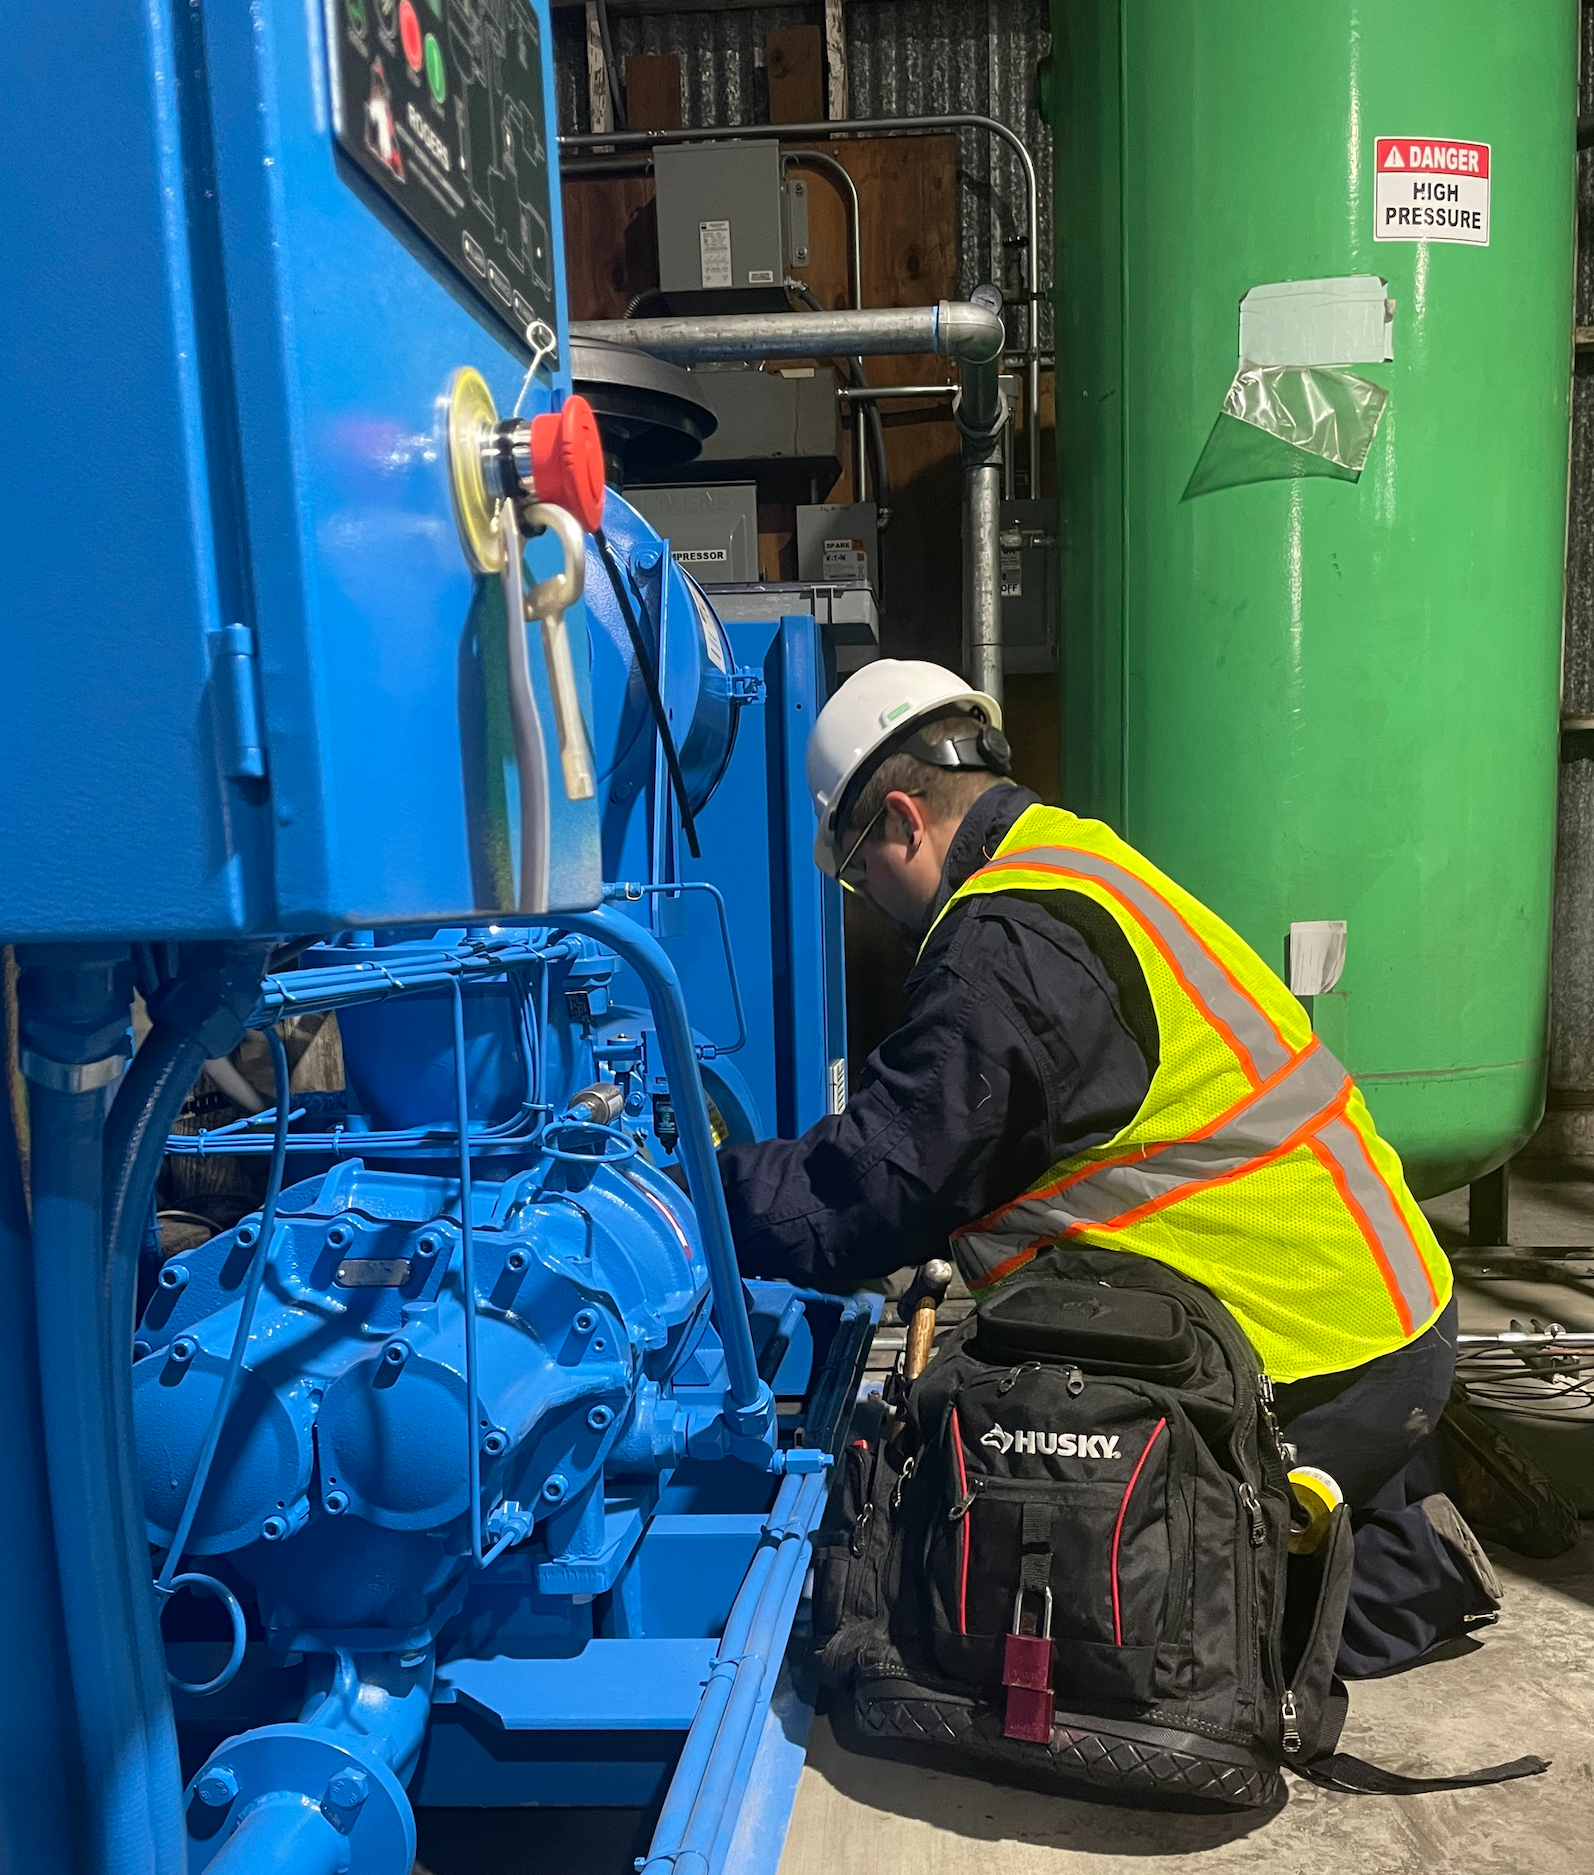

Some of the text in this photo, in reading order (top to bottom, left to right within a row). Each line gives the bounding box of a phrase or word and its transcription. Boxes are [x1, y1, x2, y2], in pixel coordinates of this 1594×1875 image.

[1409, 145, 1480, 173] DANGER
[1413, 182, 1459, 202] HIGH
[1385, 207, 1481, 230] PRESSURE
[1000, 583, 1018, 593] OFF
[1014, 1430, 1120, 1459] HUSKY
